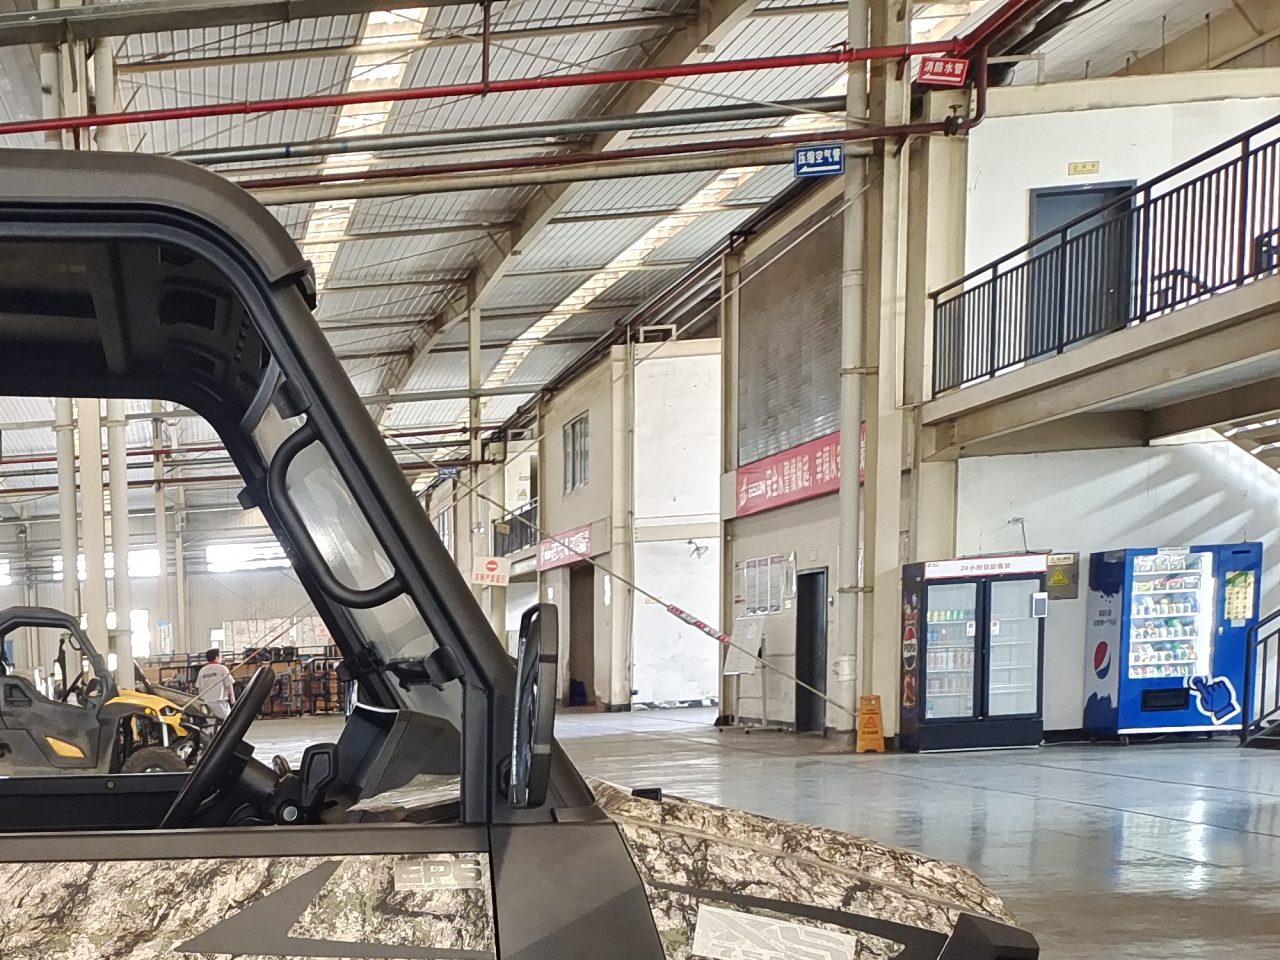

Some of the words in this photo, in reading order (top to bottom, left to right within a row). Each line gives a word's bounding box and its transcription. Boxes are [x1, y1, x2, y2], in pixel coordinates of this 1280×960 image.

[923, 60, 964, 75] 消防水管
[798, 148, 841, 164] 压缩空气管
